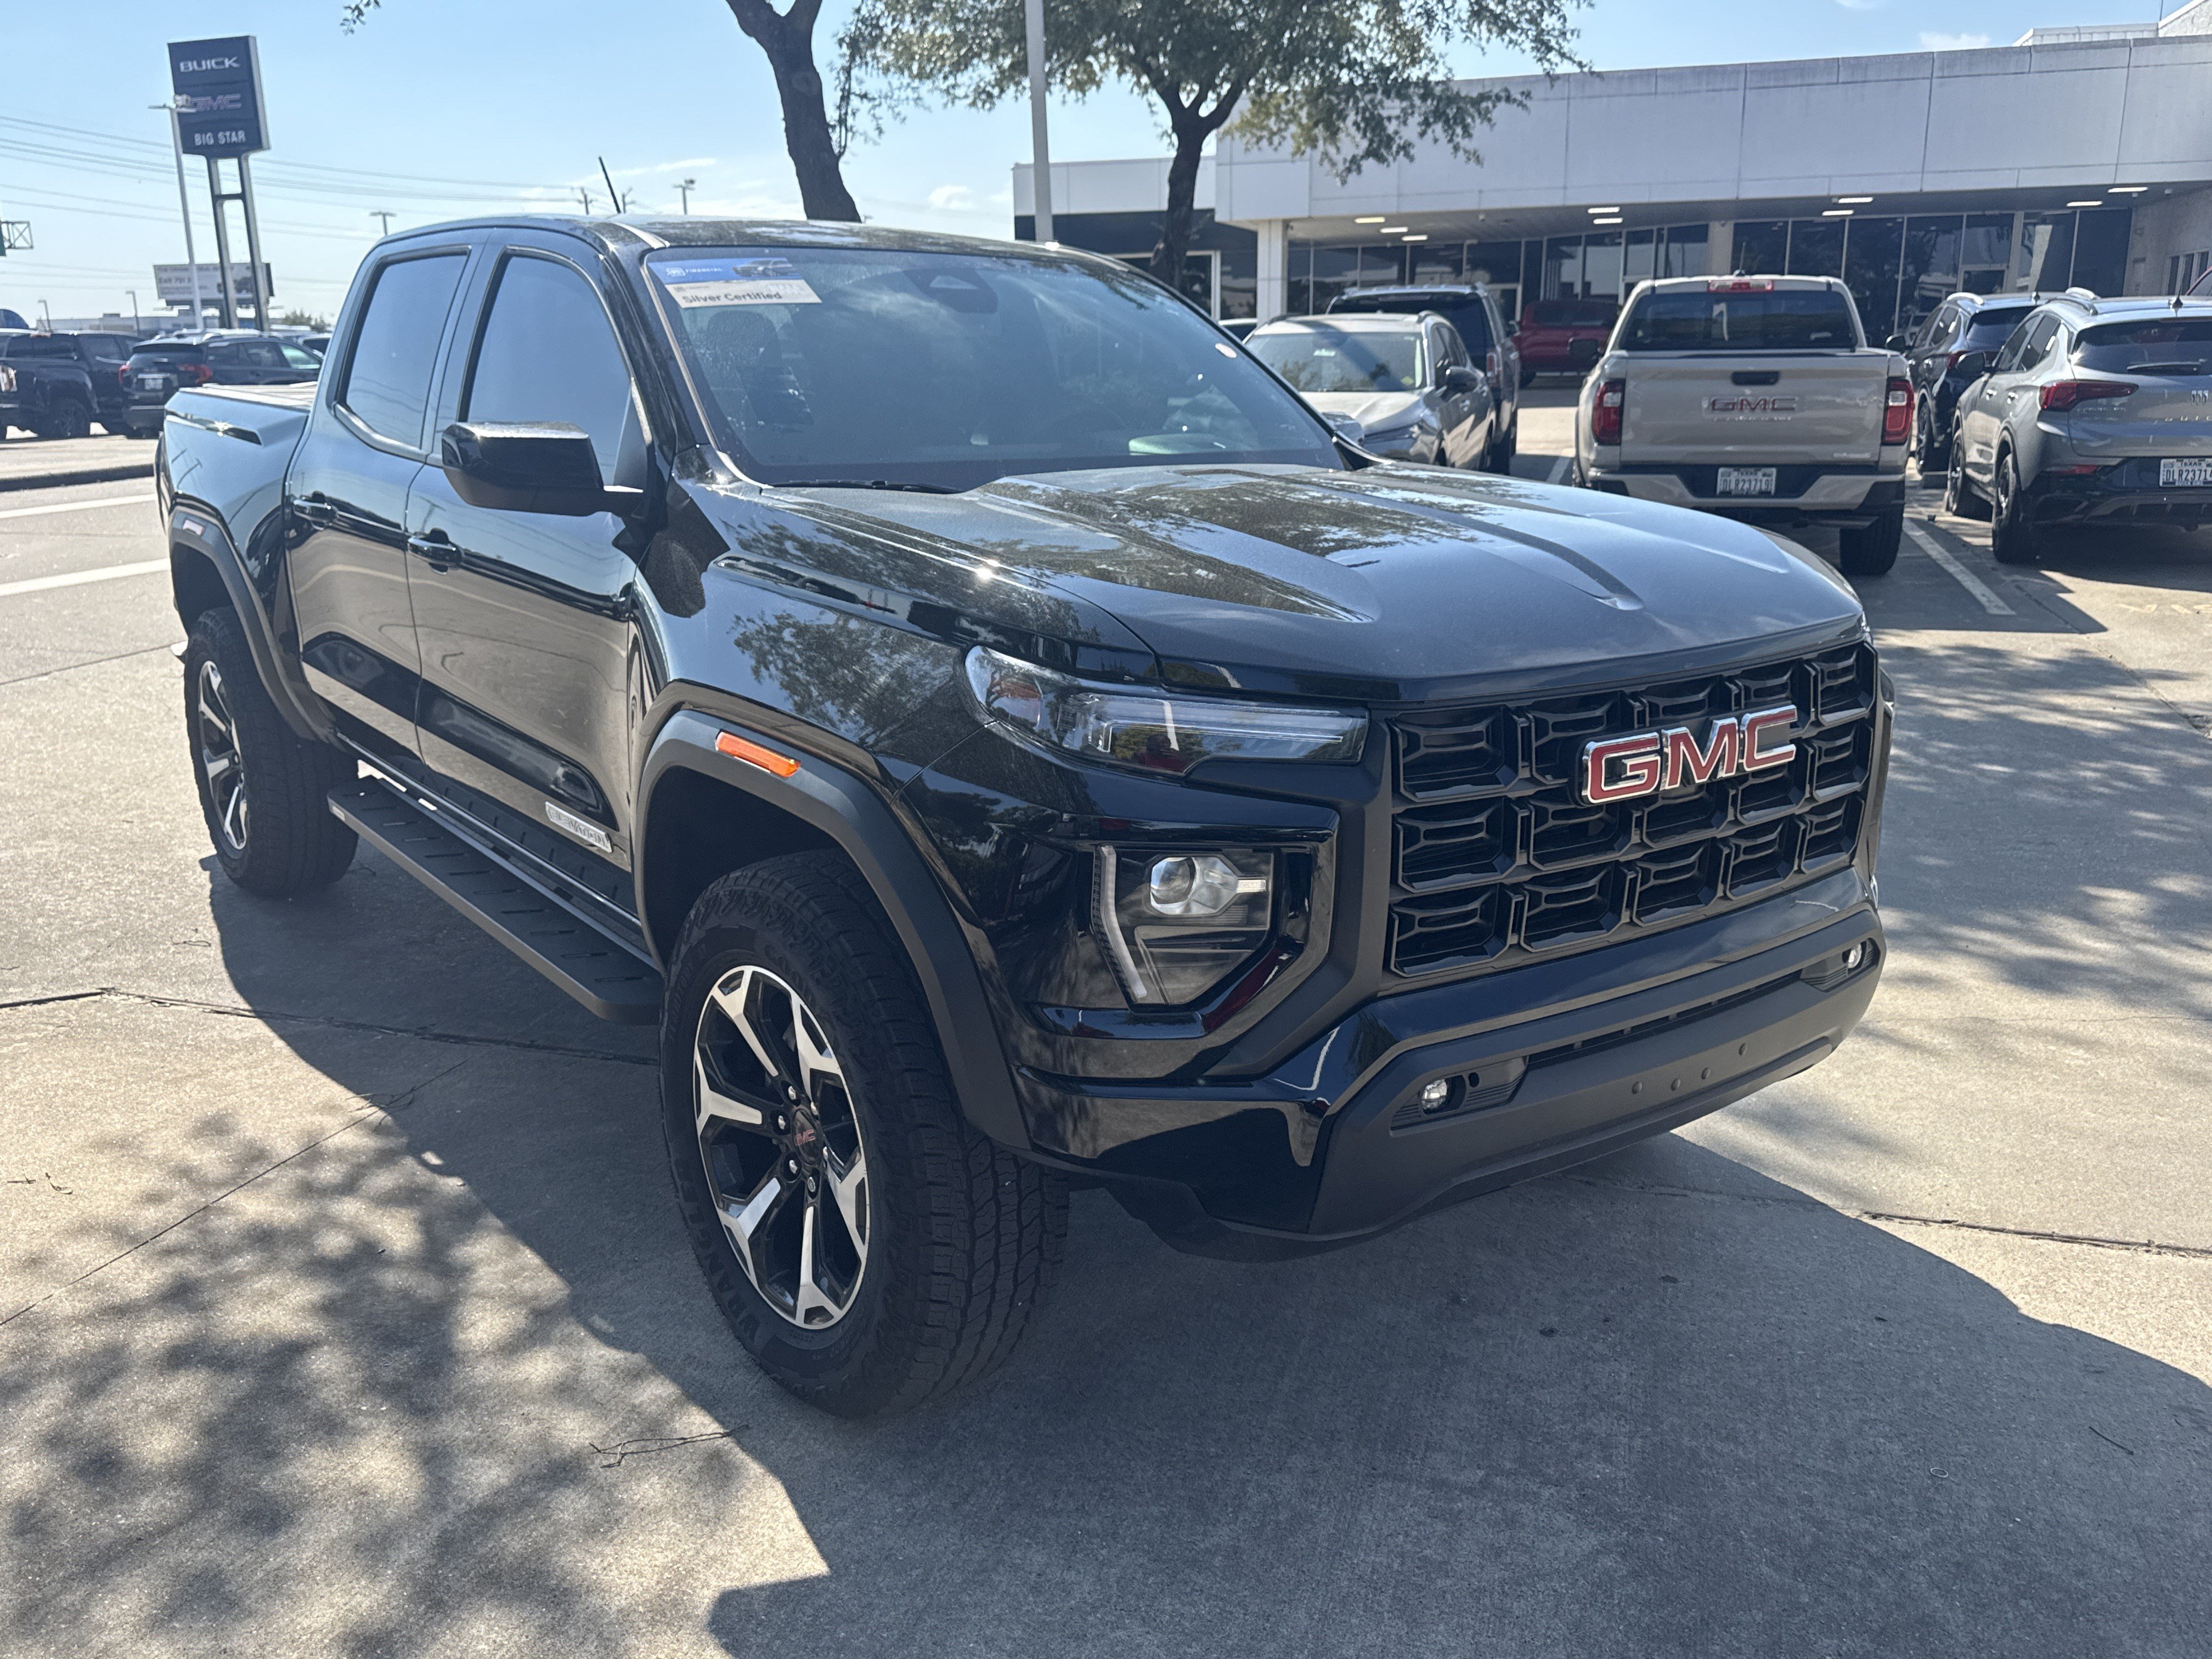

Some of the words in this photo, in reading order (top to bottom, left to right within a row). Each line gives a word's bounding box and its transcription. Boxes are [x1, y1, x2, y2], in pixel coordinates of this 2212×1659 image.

[179, 57, 240, 72] BUICK
[190, 94, 241, 111] GMC
[194, 132, 214, 146] BIG
[218, 130, 246, 145] STAR
[682, 293, 721, 303] Silver
[724, 291, 782, 302] Certified
[1711, 396, 1799, 412] GMC
[1582, 704, 1797, 804] GMC
